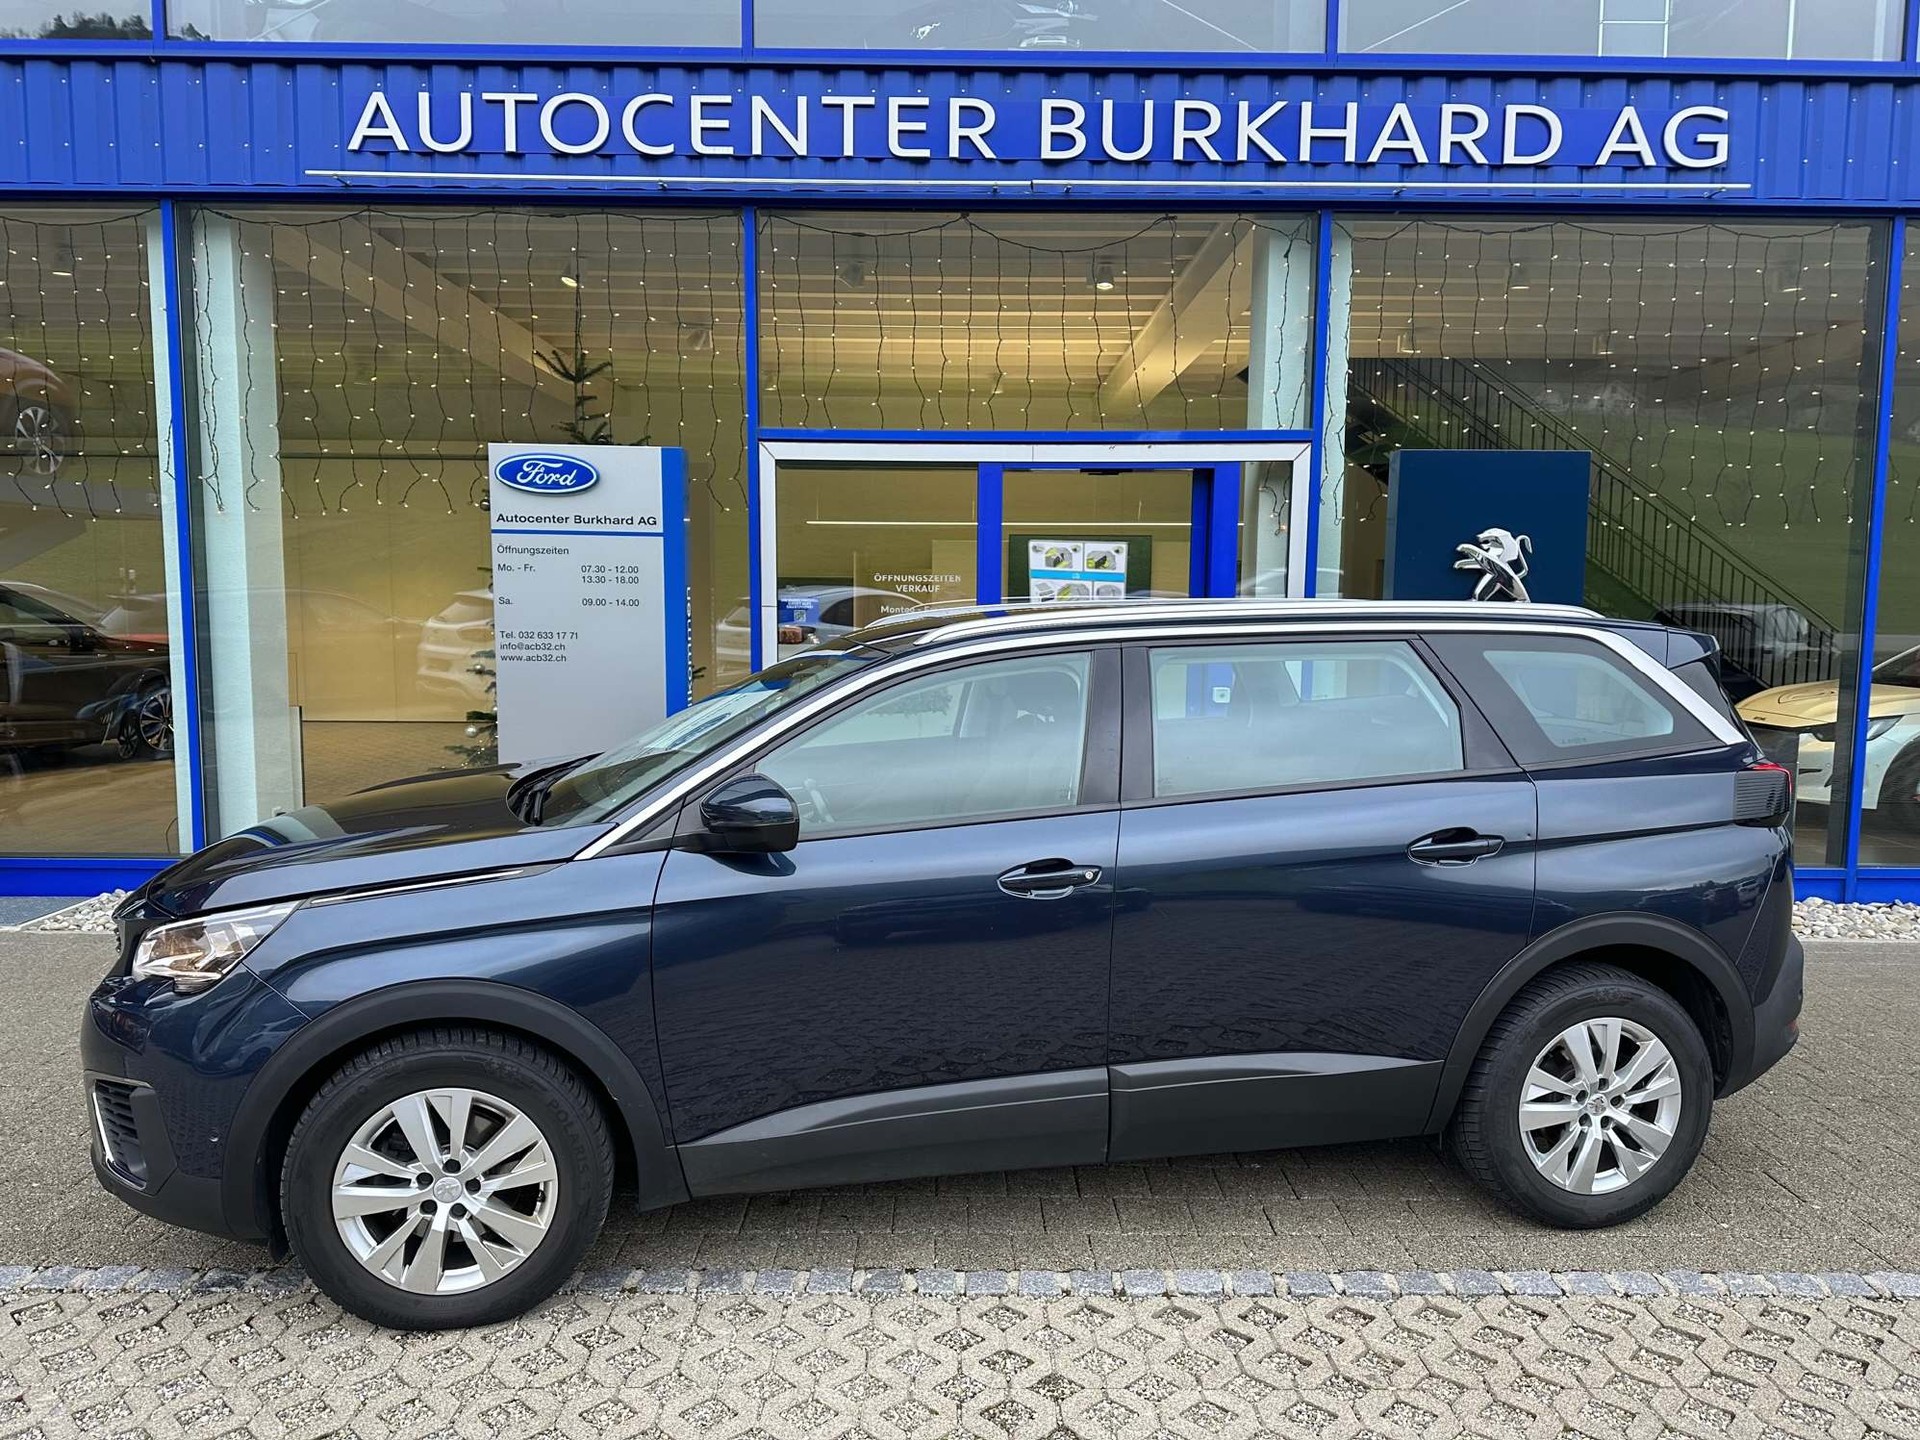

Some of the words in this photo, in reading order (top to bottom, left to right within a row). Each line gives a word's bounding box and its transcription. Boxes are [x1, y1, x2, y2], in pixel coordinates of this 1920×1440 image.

[347, 91, 997, 159] AUTOCENTER
[1039, 98, 1563, 165] BURKHARD
[1594, 105, 1730, 169] AG
[516, 460, 578, 486] Ford
[496, 513, 570, 524] Autocenter
[573, 514, 634, 526] Burkhard
[637, 516, 657, 526] AG
[496, 544, 570, 556] Öffnungszeiten
[497, 563, 515, 572] Mo.
[523, 564, 536, 573] Fr.
[580, 565, 606, 574] 07.30
[615, 566, 639, 574] 12.00
[581, 575, 606, 584] 13.30
[615, 576, 640, 585] 18.00
[873, 573, 961, 583] ÖFFNUNGSZEITEN
[896, 584, 941, 593] VERKAUF
[498, 597, 513, 606] Sa.
[581, 598, 607, 607] 09.00
[616, 599, 640, 607] 14.00
[499, 630, 517, 640] Tel.
[518, 631, 535, 640] 032
[537, 631, 554, 640] 633
[556, 632, 567, 640] 17
[569, 632, 578, 640] 71
[500, 642, 566, 651] info@acb32.ch
[500, 653, 567, 662] www.acb32.ch
